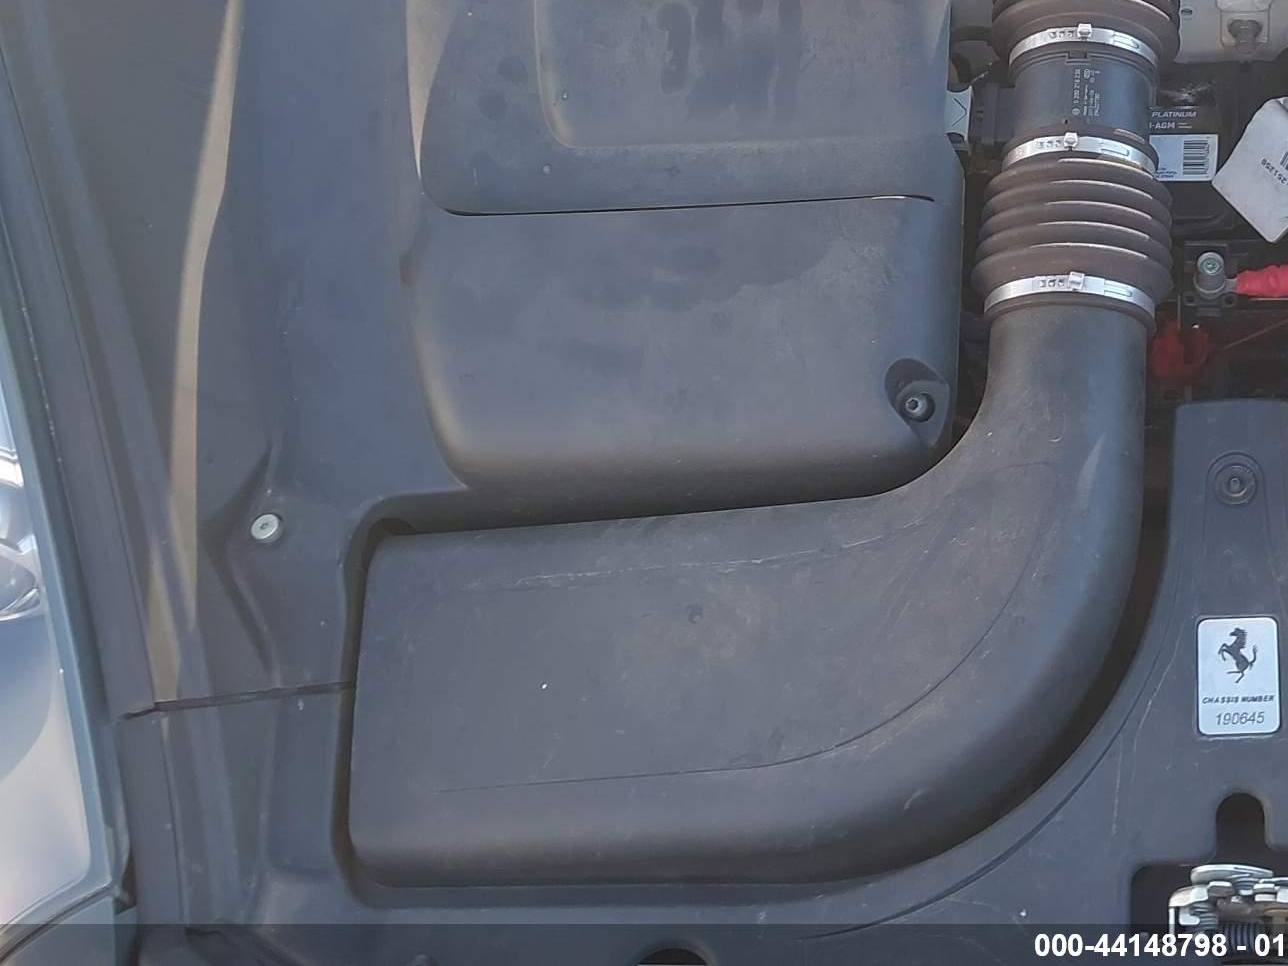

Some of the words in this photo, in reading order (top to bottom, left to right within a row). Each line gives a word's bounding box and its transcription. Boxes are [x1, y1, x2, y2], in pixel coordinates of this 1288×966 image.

[1151, 111, 1198, 119] PLATINUM
[1202, 696, 1239, 704] CHASSIS
[1240, 694, 1275, 703] NUMBER
[1216, 711, 1265, 725] 190645
